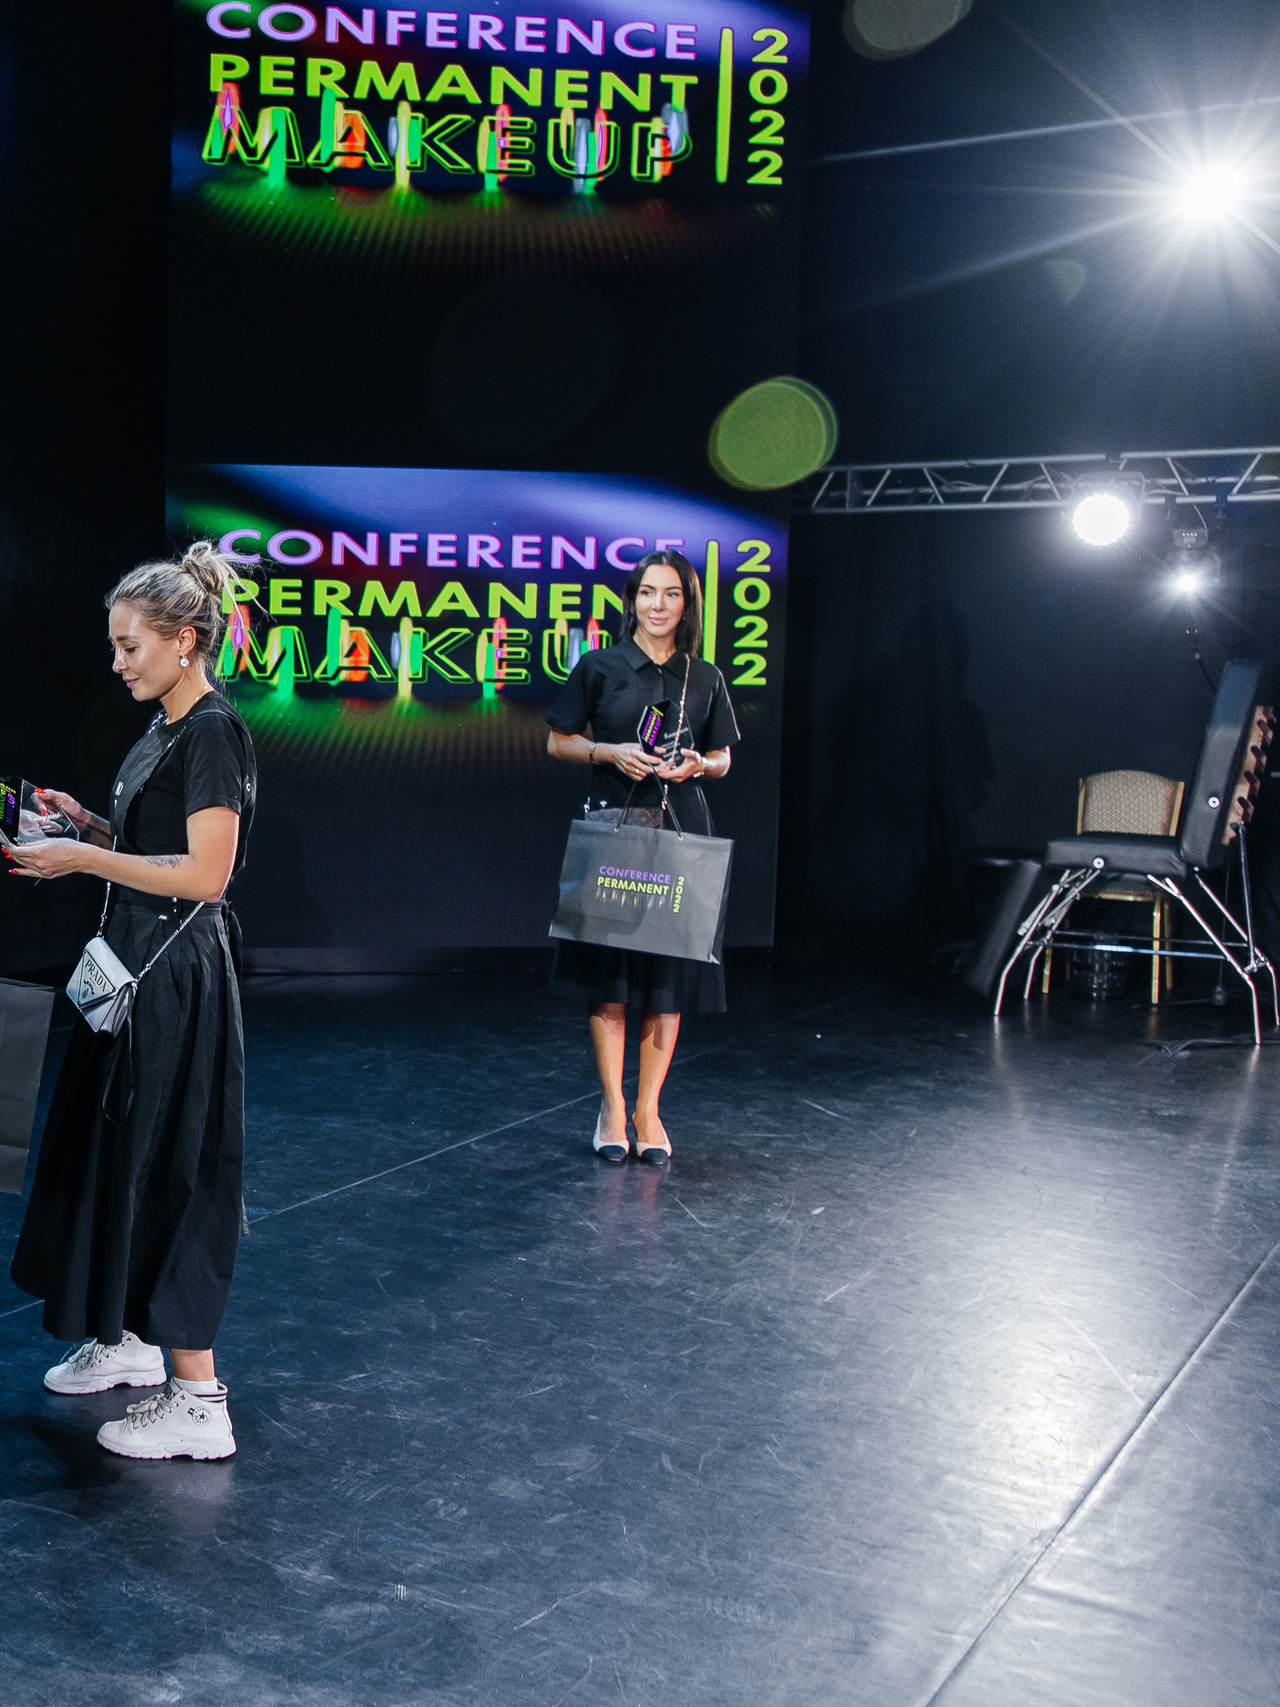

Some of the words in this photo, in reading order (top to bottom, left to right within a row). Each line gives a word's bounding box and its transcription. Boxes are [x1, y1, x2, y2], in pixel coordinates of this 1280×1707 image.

[206, 1, 698, 60] CONFERENCE
[209, 53, 699, 112] PERMANENT
[747, 27, 790, 186] 2022
[202, 104, 693, 183] MAKEUP
[221, 578, 624, 622] PERMANEN
[731, 539, 771, 686] 2022
[596, 876, 670, 896] PERMANENT
[599, 865, 672, 885] CONFERENCE
[672, 876, 685, 914] 2022
[84, 959, 108, 992] PRADA
